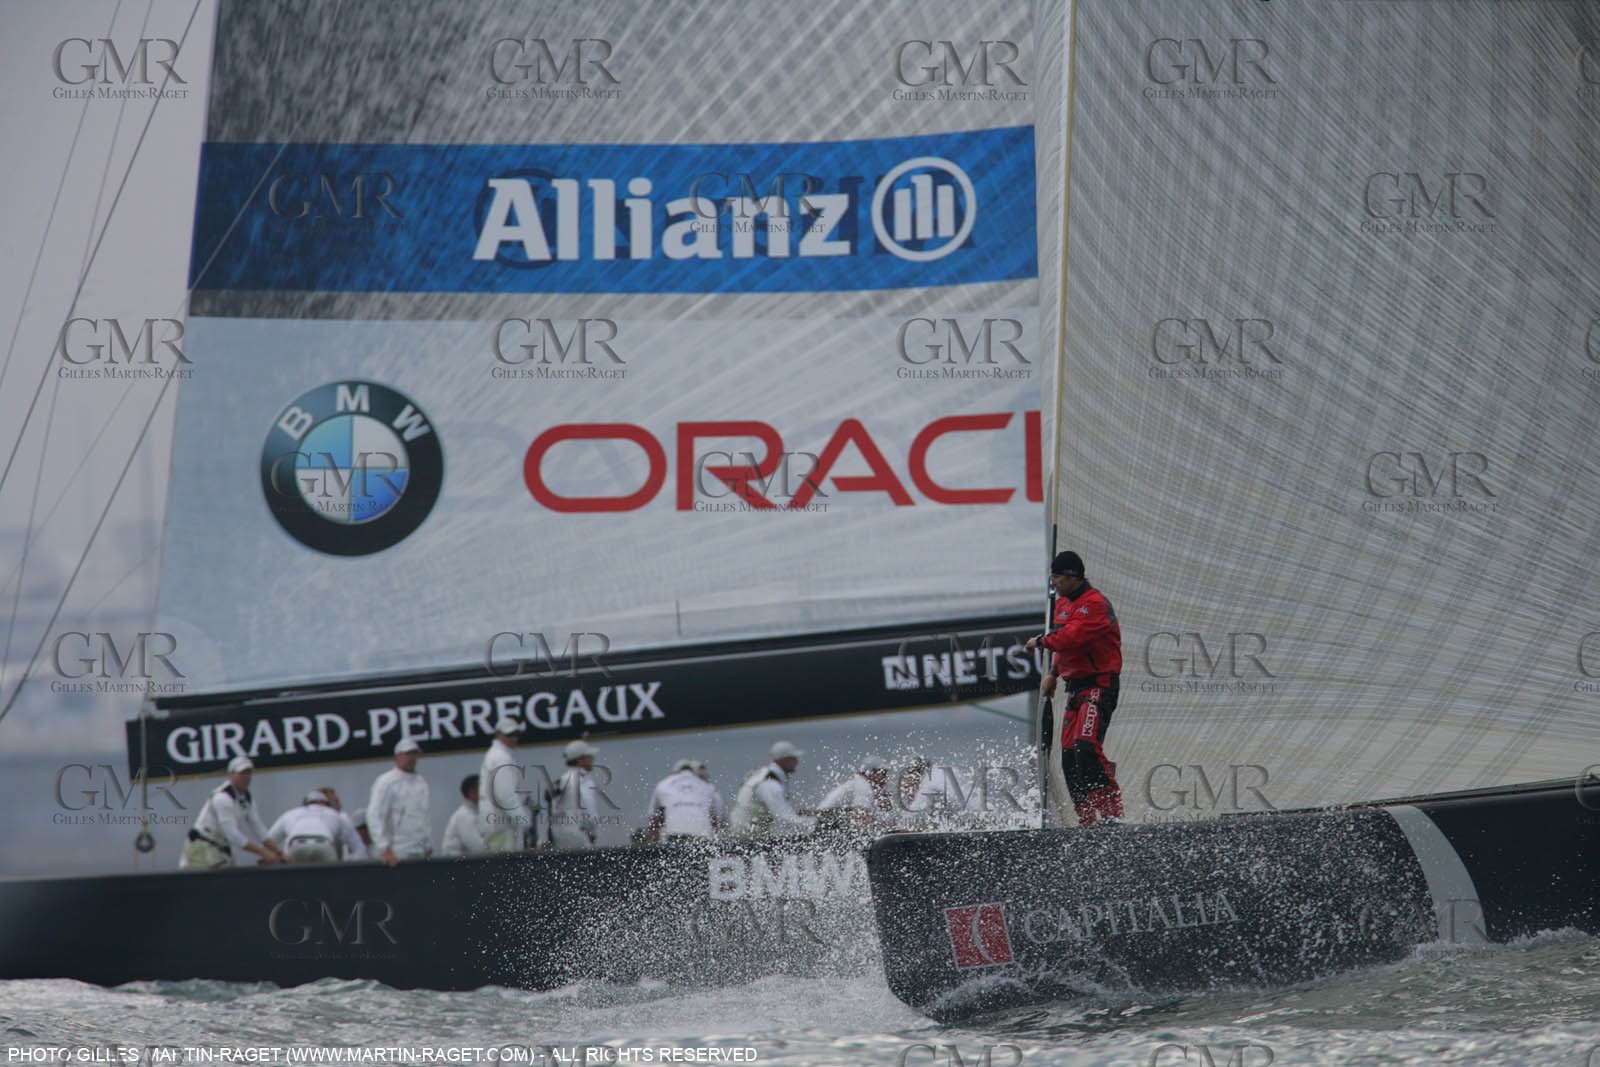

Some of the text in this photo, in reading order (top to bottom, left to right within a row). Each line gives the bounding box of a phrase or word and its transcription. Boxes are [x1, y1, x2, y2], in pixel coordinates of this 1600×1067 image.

[472, 177, 851, 261] Allianz
[279, 383, 431, 441] BMW
[165, 681, 666, 765] GIRARD-PERREGAUX
[708, 850, 859, 901] BMW
[1024, 888, 1240, 944] CAPITALIA
